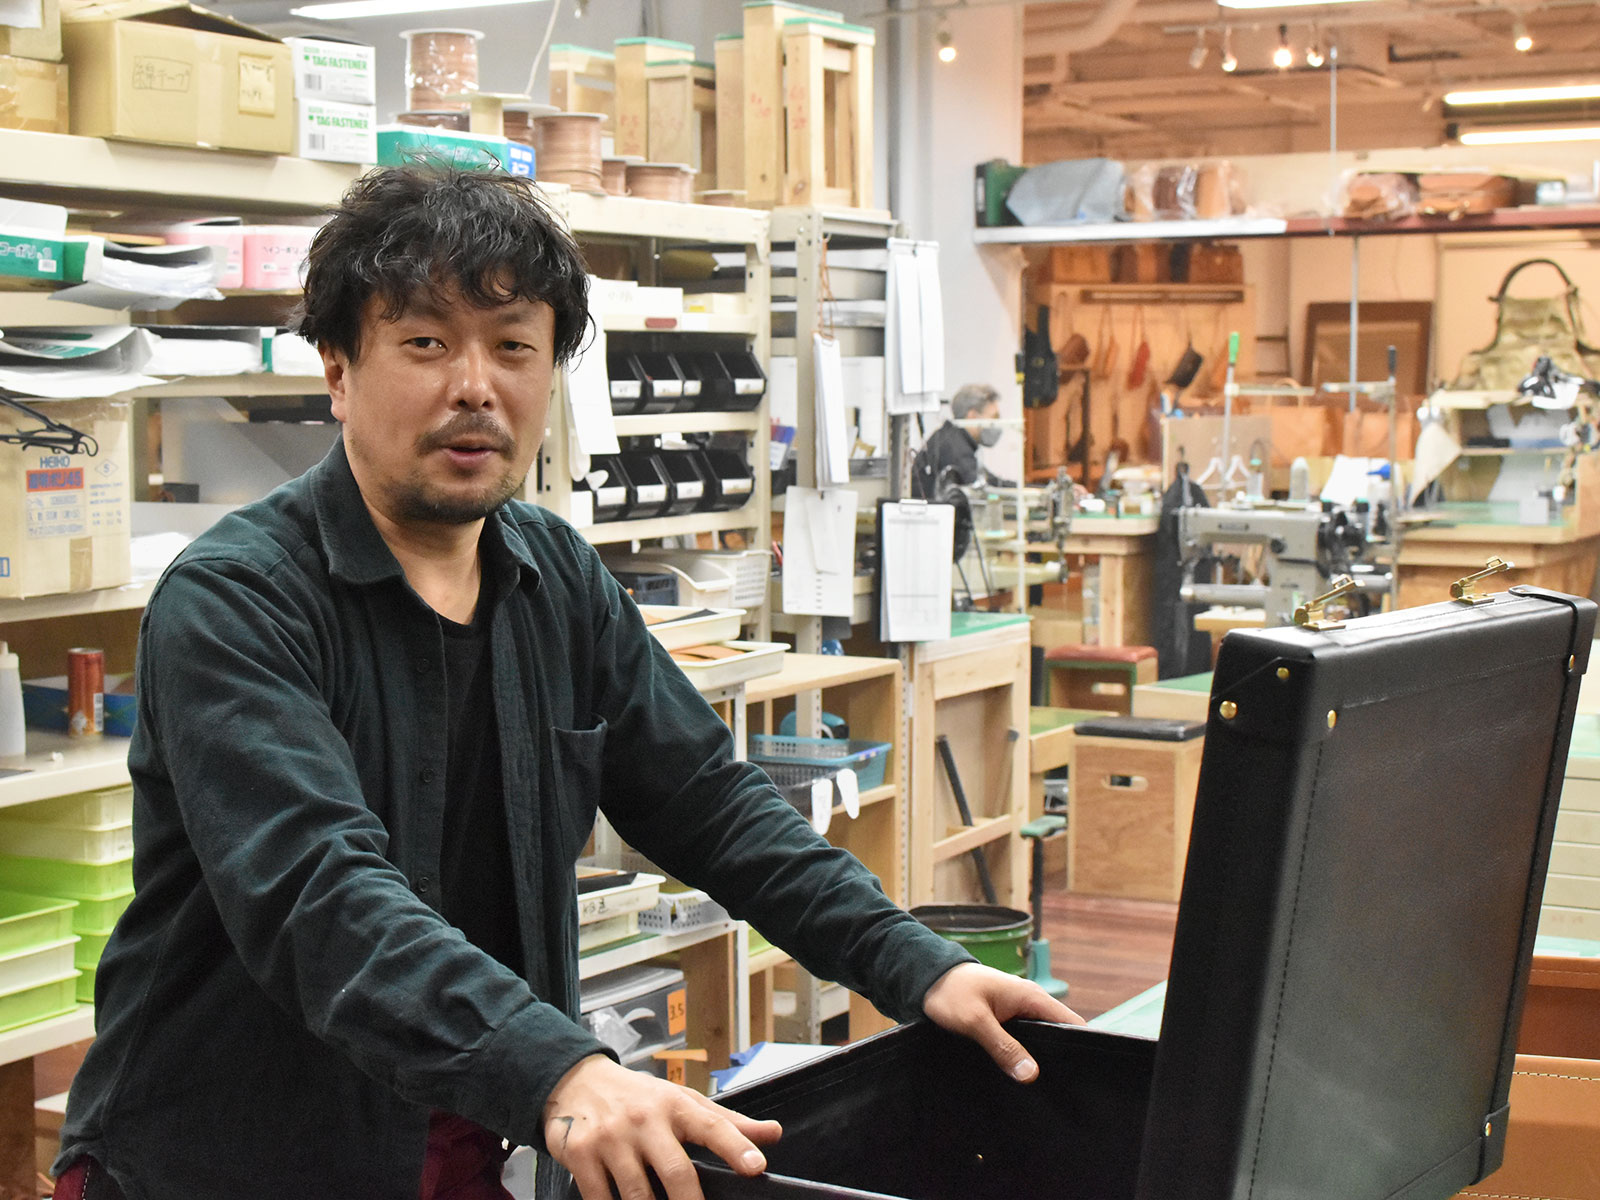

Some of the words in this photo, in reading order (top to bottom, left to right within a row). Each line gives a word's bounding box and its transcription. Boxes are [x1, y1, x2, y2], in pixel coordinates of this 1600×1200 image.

[312, 55, 328, 67] TAG
[329, 57, 367, 70] FASTENER
[316, 115, 331, 126] TAG
[332, 116, 368, 129] FASTENER
[40, 456, 70, 469] HEIKO
